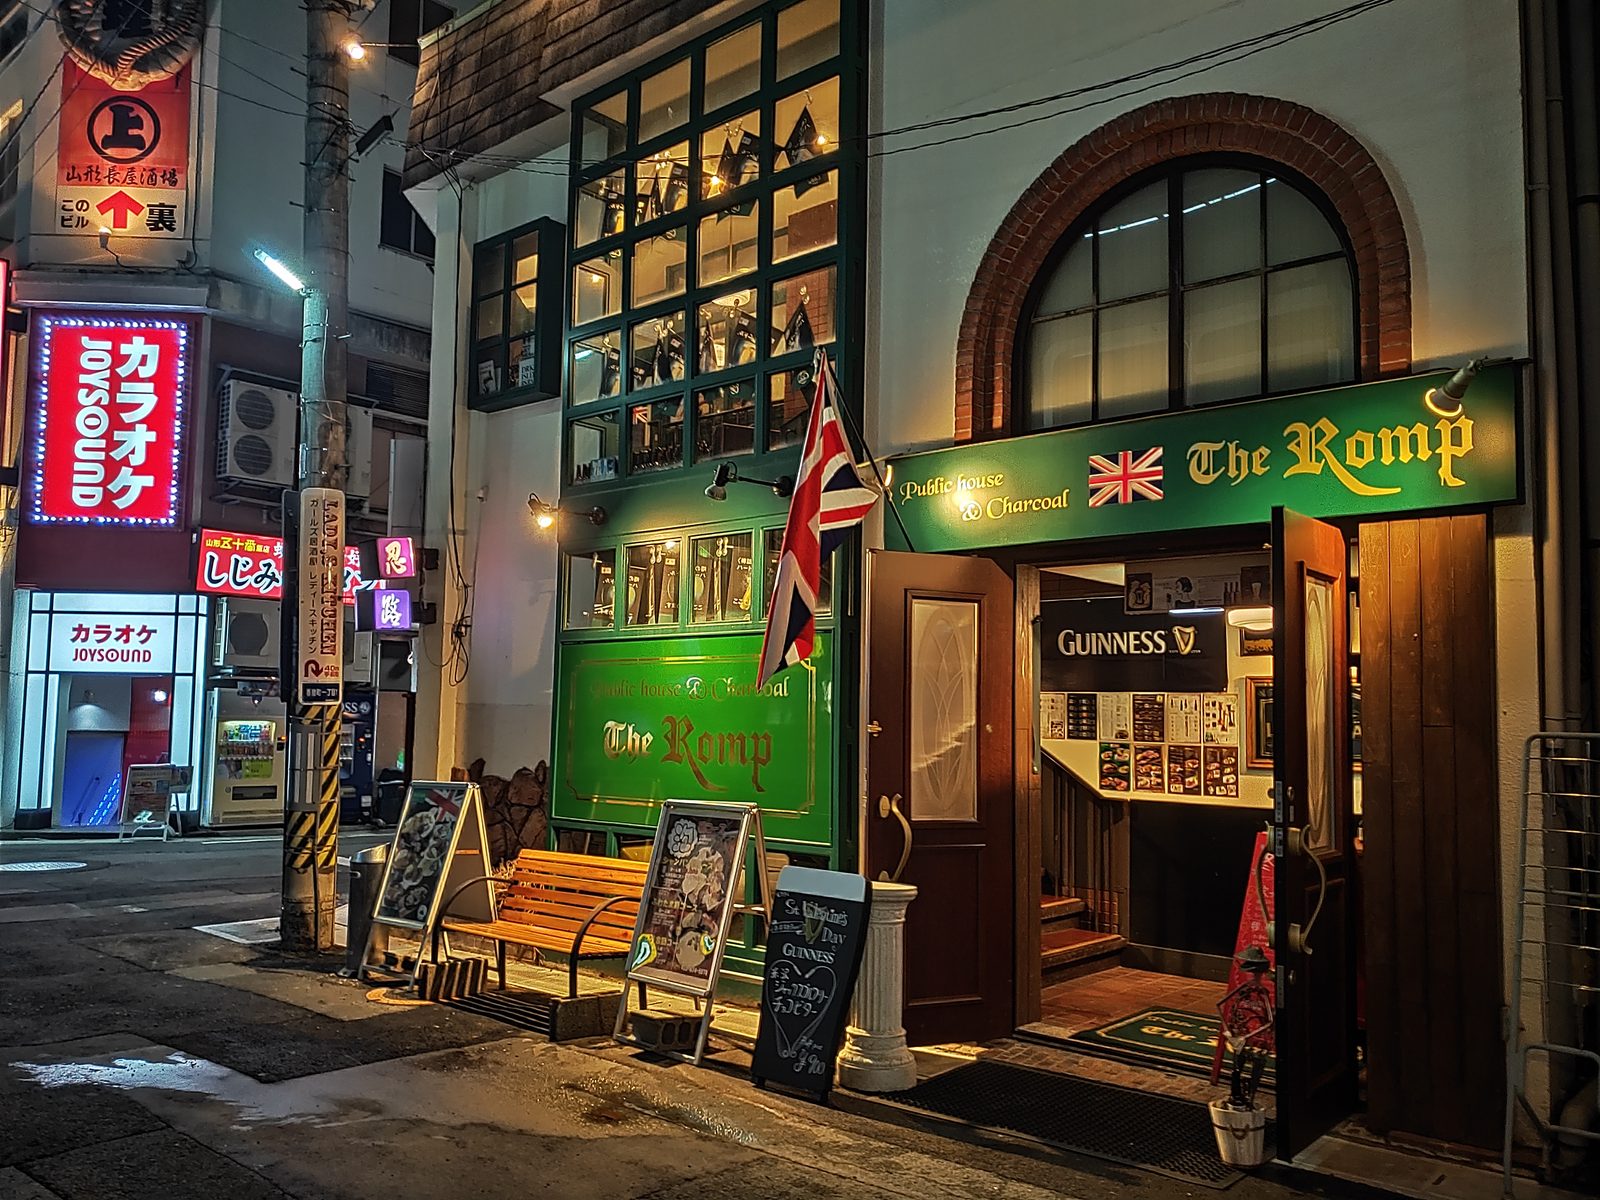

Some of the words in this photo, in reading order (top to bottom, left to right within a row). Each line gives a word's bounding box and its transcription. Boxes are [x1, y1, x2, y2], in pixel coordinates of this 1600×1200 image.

[101, 104, 146, 150] 上
[66, 165, 178, 187] 山形長屋酒場
[61, 199, 89, 212] この
[145, 202, 177, 232] 裏
[61, 215, 89, 228] ビル
[72, 336, 112, 508] JOYSOUND
[106, 336, 160, 510] カラオケ
[1187, 440, 1271, 486] The
[1283, 415, 1474, 496] Romp
[900, 479, 952, 505] Public
[957, 473, 1004, 492] house
[986, 489, 1069, 519] Charcoal
[385, 541, 407, 575] 忍
[70, 623, 157, 644] カラオケ
[1058, 629, 1167, 656] GUINNESS
[72, 648, 152, 663] JOYSOUND
[640, 679, 681, 696] house
[603, 720, 653, 764] The
[661, 714, 772, 793] Romp
[821, 927, 847, 944] Day
[782, 943, 836, 964] GUINNESS
